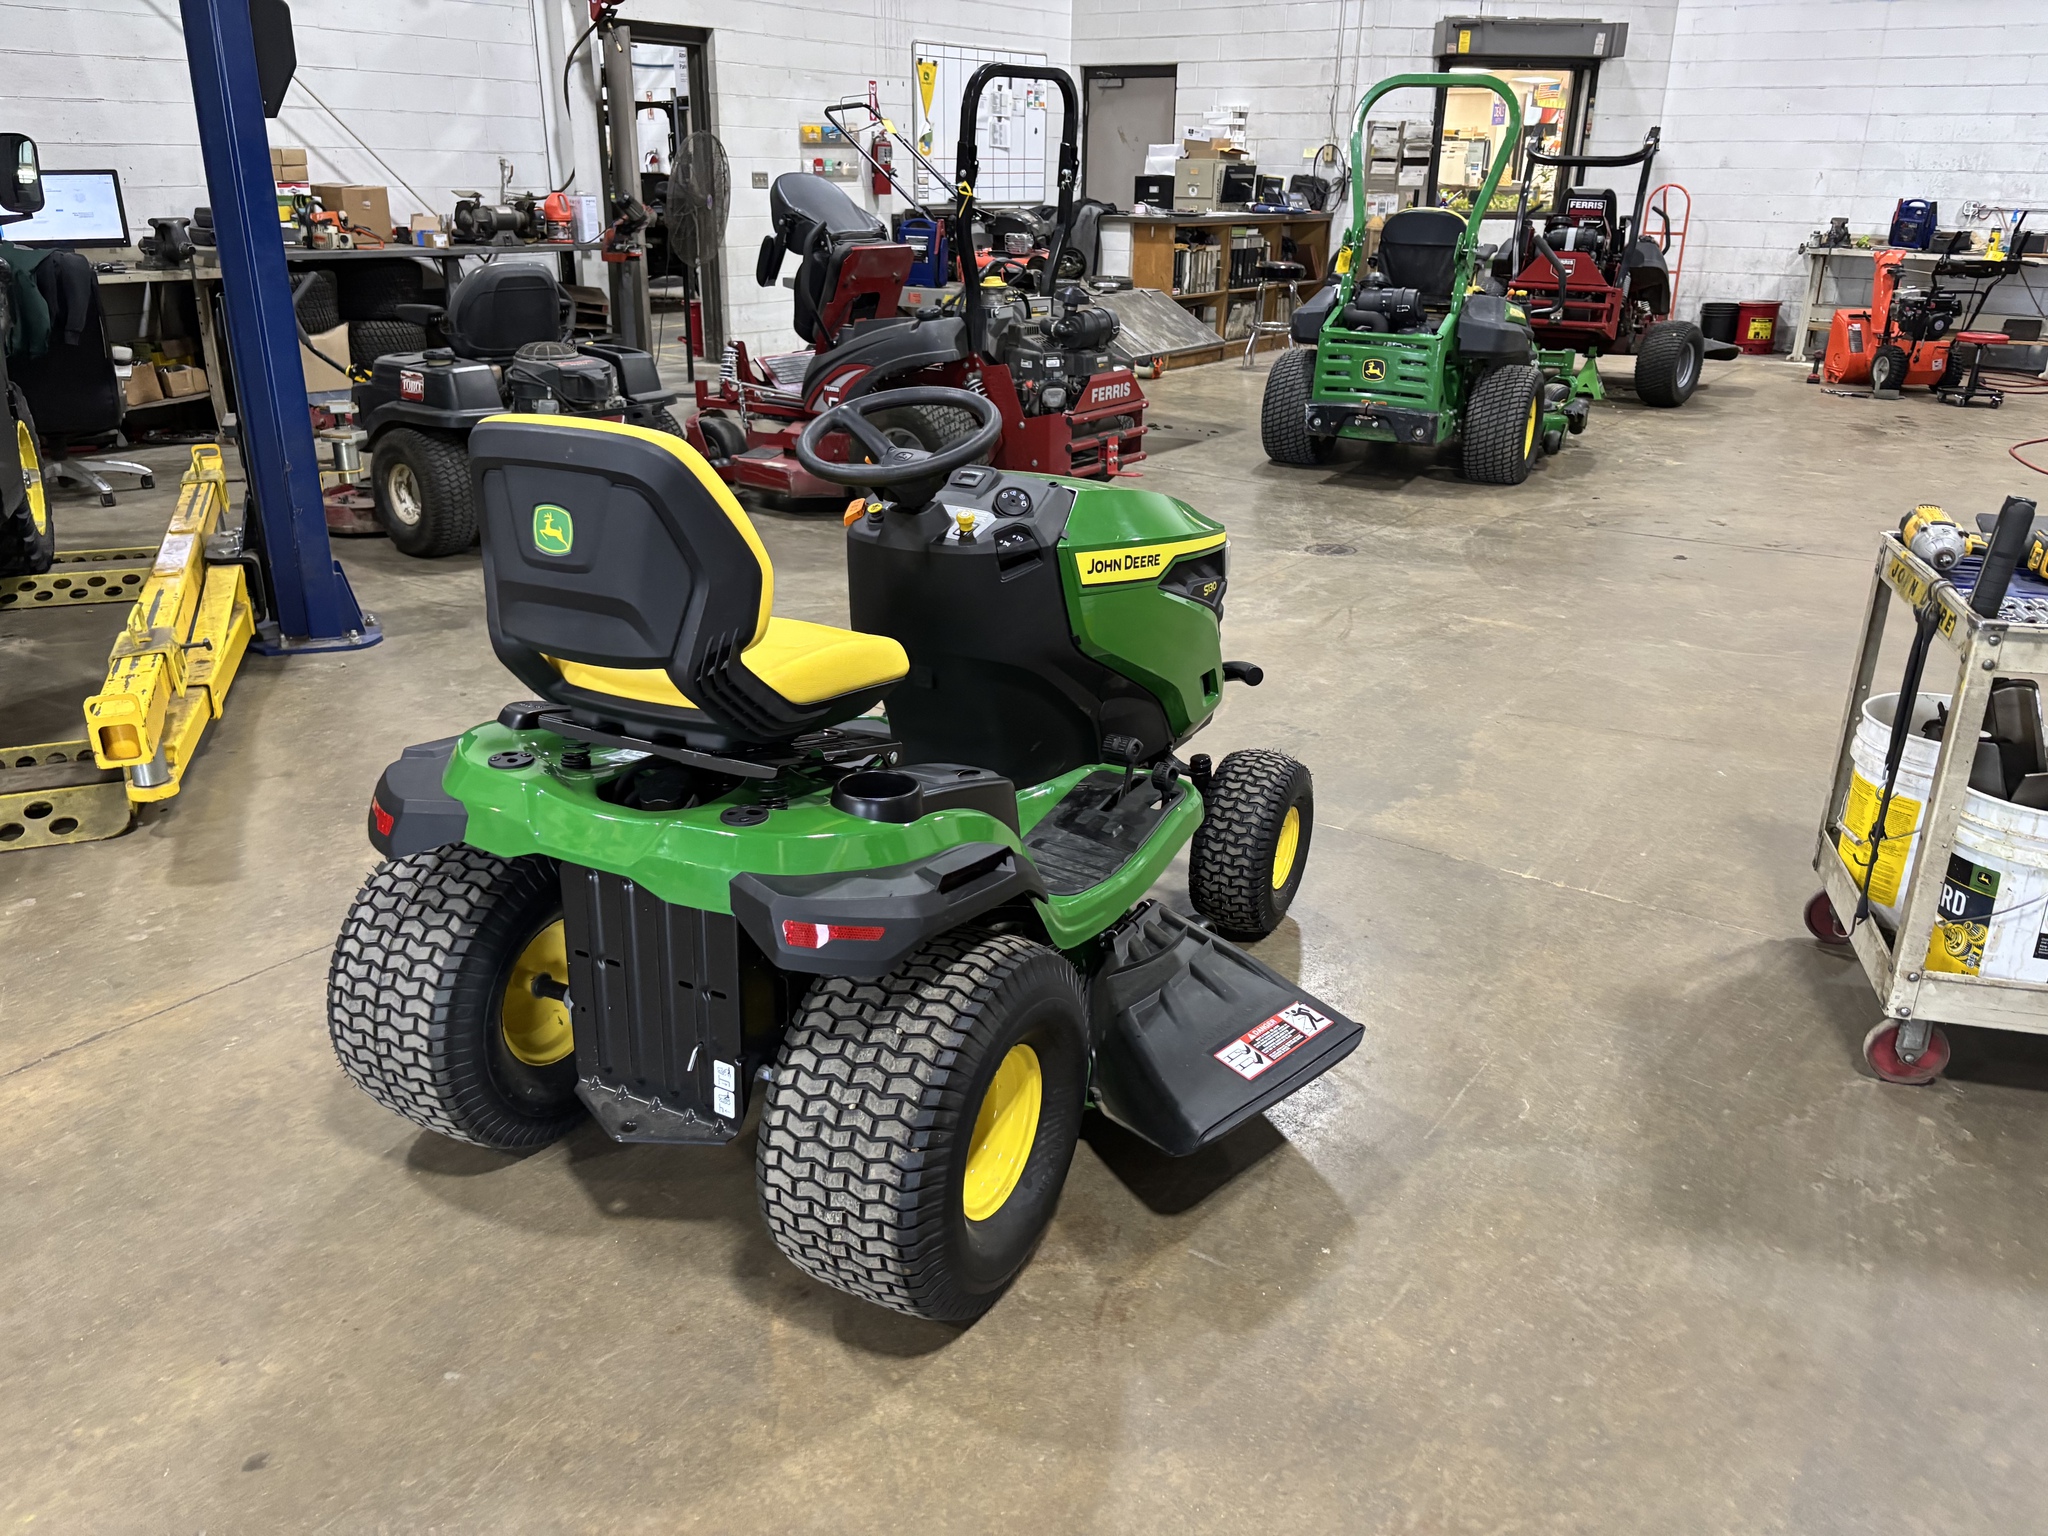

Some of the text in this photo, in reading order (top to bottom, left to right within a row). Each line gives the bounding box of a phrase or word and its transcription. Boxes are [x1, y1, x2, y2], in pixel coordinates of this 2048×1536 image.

[1570, 200, 1604, 210] FERRIS
[1091, 382, 1131, 403] FERRIS
[1087, 553, 1161, 575] JOHN DEERE
[1891, 563, 1919, 597] JON
[1252, 1019, 1278, 1037] DANGER
